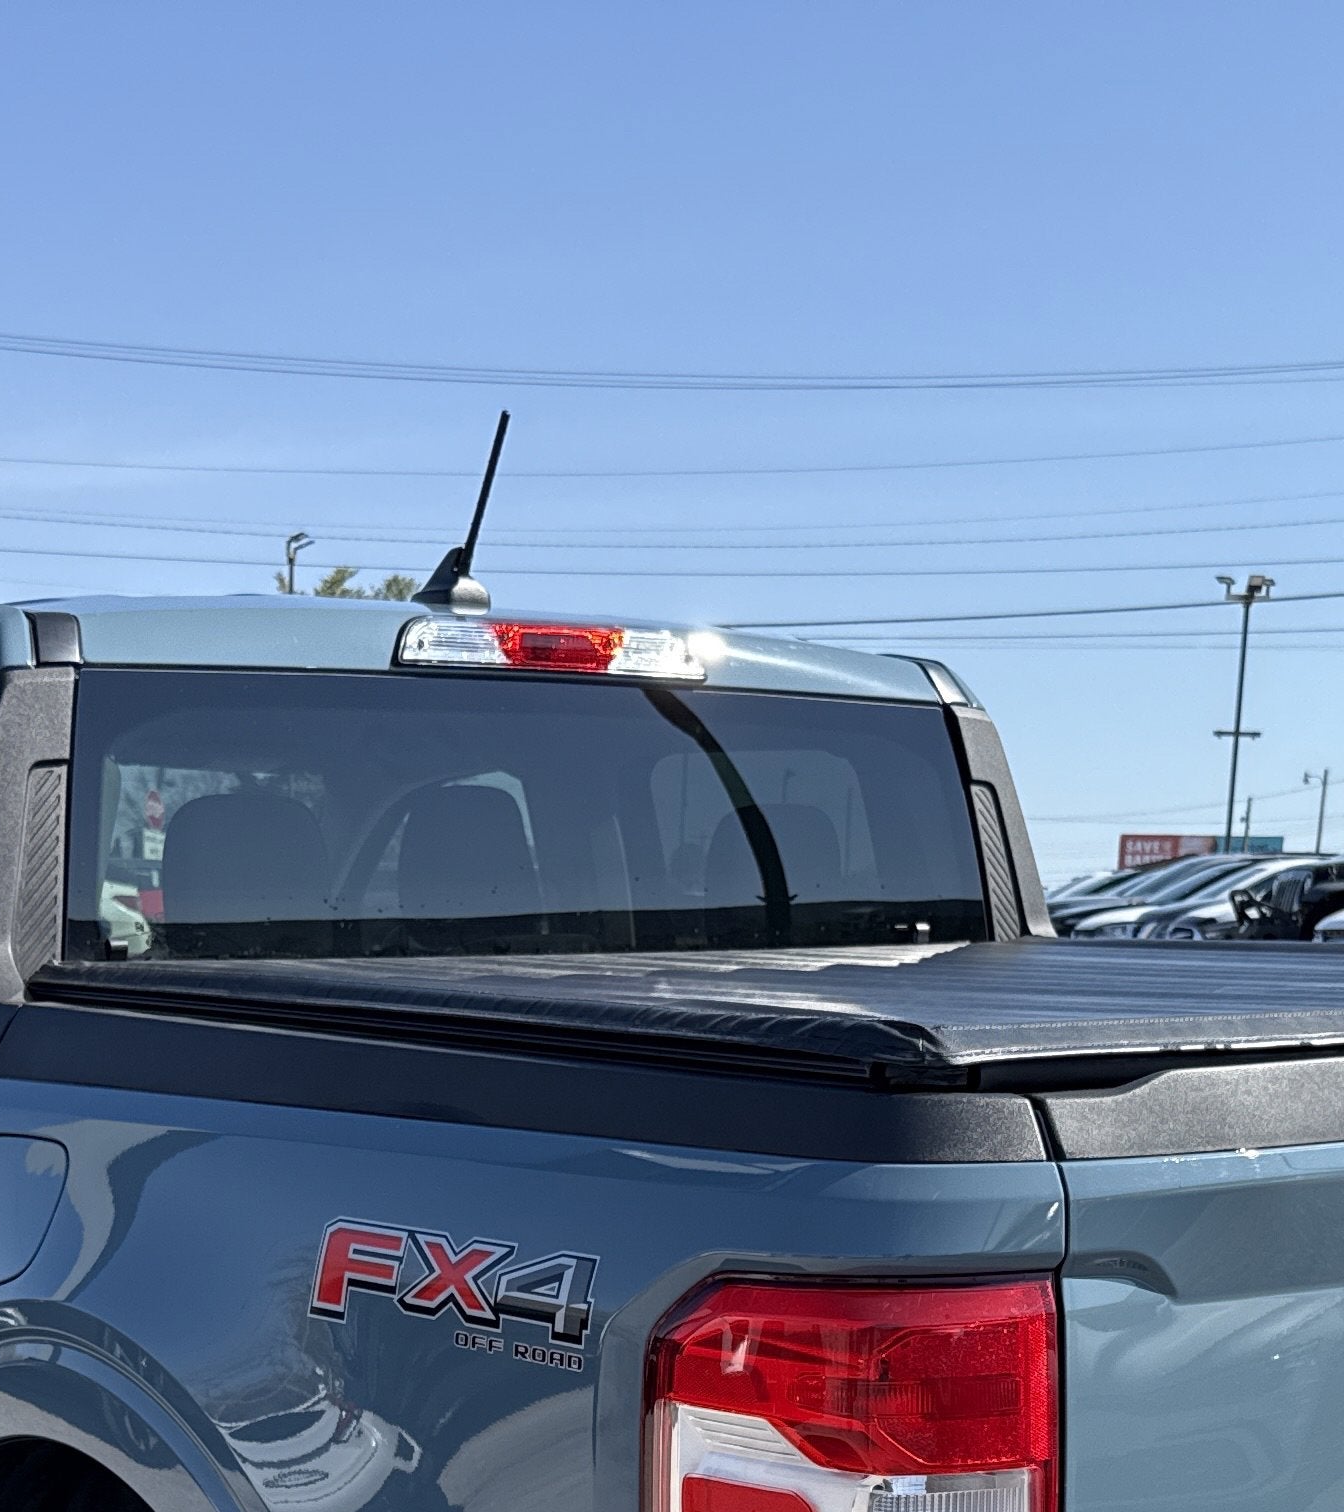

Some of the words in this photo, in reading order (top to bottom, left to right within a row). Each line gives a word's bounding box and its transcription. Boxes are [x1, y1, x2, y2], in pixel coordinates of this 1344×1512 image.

[307, 1216, 600, 1349] FX4
[454, 1331, 504, 1353] OFF
[513, 1343, 584, 1372] ROAD
